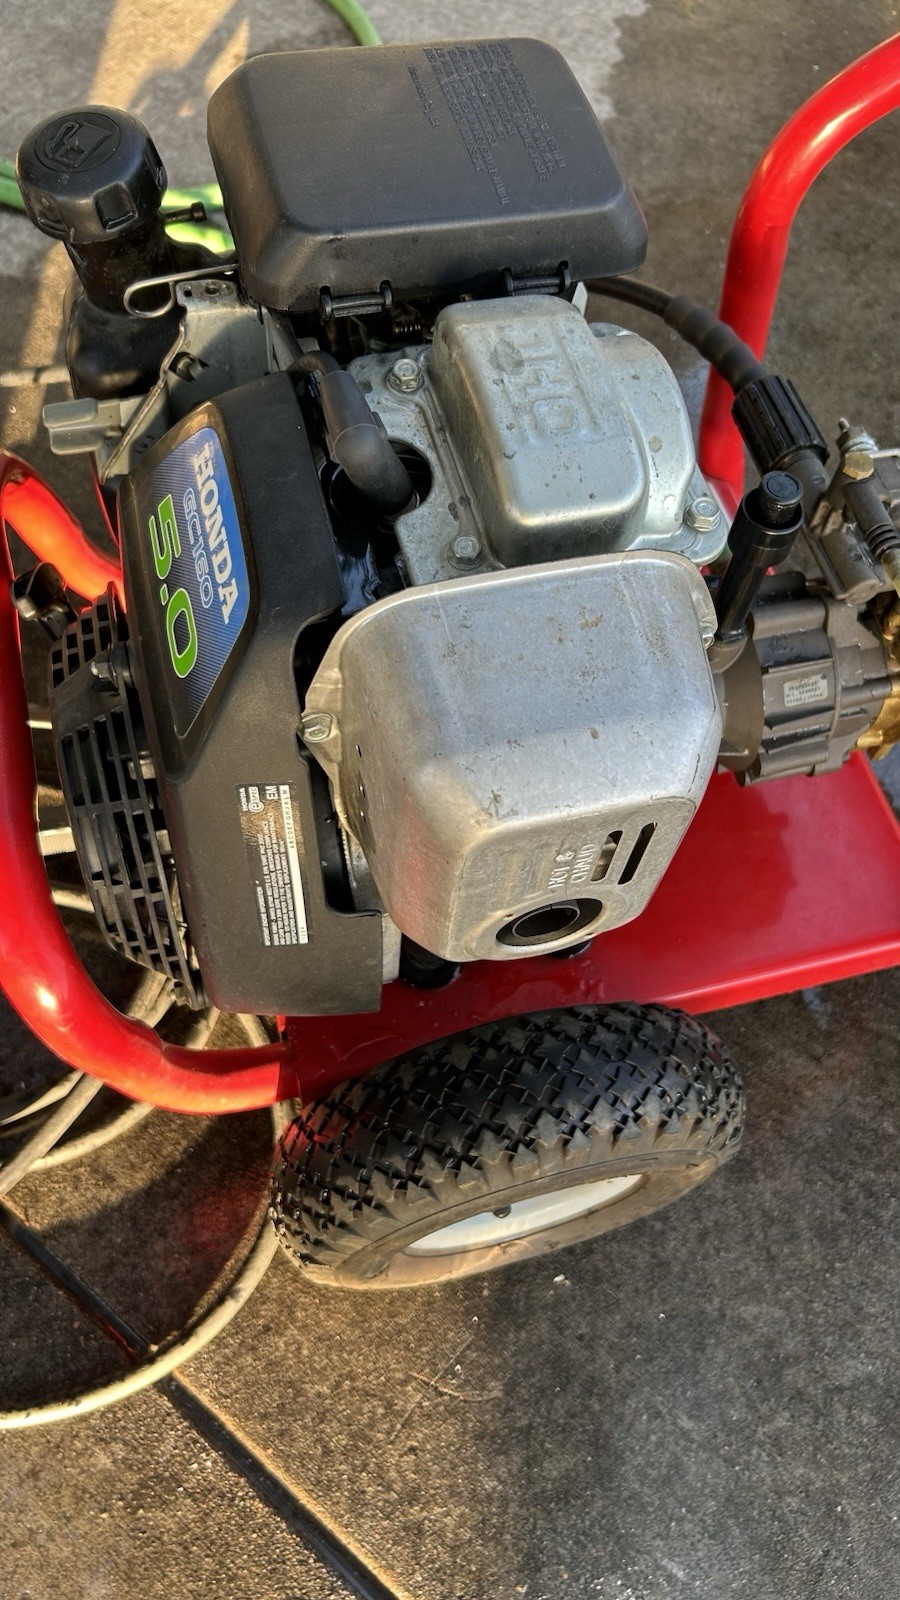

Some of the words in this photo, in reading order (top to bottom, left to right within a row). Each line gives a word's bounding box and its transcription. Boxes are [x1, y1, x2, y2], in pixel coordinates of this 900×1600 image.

[183, 488, 214, 609] GC160
[193, 441, 239, 625] HONDA
[149, 494, 198, 679] 5.0
[239, 787, 248, 811] HONDA
[265, 784, 278, 799] EM
[548, 866, 570, 888] HOT
[569, 844, 596, 883] CHAUD
